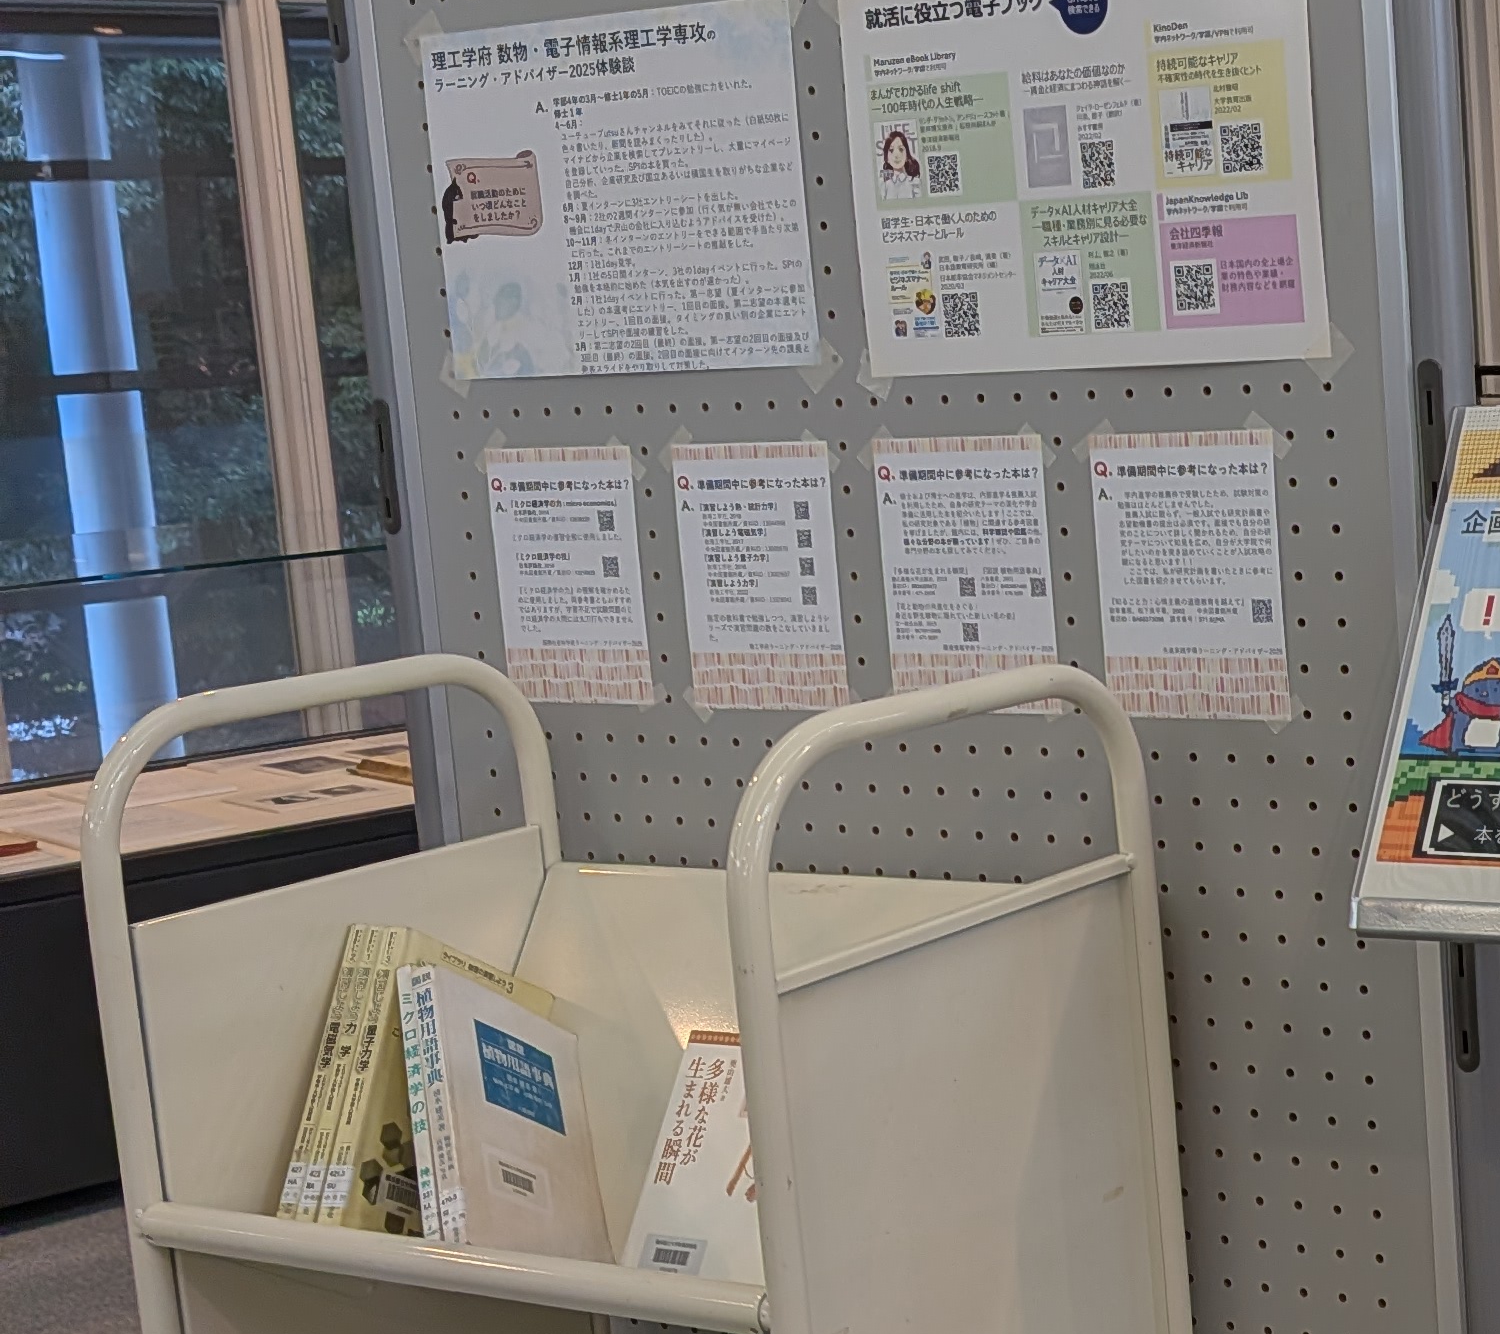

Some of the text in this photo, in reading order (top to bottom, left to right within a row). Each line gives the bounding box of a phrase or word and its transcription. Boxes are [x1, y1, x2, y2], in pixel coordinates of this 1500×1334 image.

[431, 22, 716, 71] 理工学府 数物・電子情報系理工学専攻の
[1156, 53, 1238, 72] 持続可能なキャリア
[434, 56, 636, 92] ラーニング・アドバイザー2025体験談
[1021, 63, 1125, 84] 給料はあなたの価値なのか
[881, 210, 997, 230] 留学生・日本で働く人のための
[882, 227, 964, 244] ビジネスマナーとルール
[1169, 224, 1223, 240] 会社四季報
[899, 467, 1038, 482] 準備期間中に参考になった本は？
[1116, 462, 1268, 478] 準備期間中に参考になった本は？
[509, 479, 630, 492] 準備期間中に参考になった本は？
[697, 477, 826, 490] 準備期間中に参考になった本は？
[416, 987, 443, 1088] 植物用語事典
[401, 993, 427, 1135] ミクロ経済学の技
[654, 1057, 707, 1186] 生まれる瞬間
[680, 1058, 725, 1166] 多様な花が
